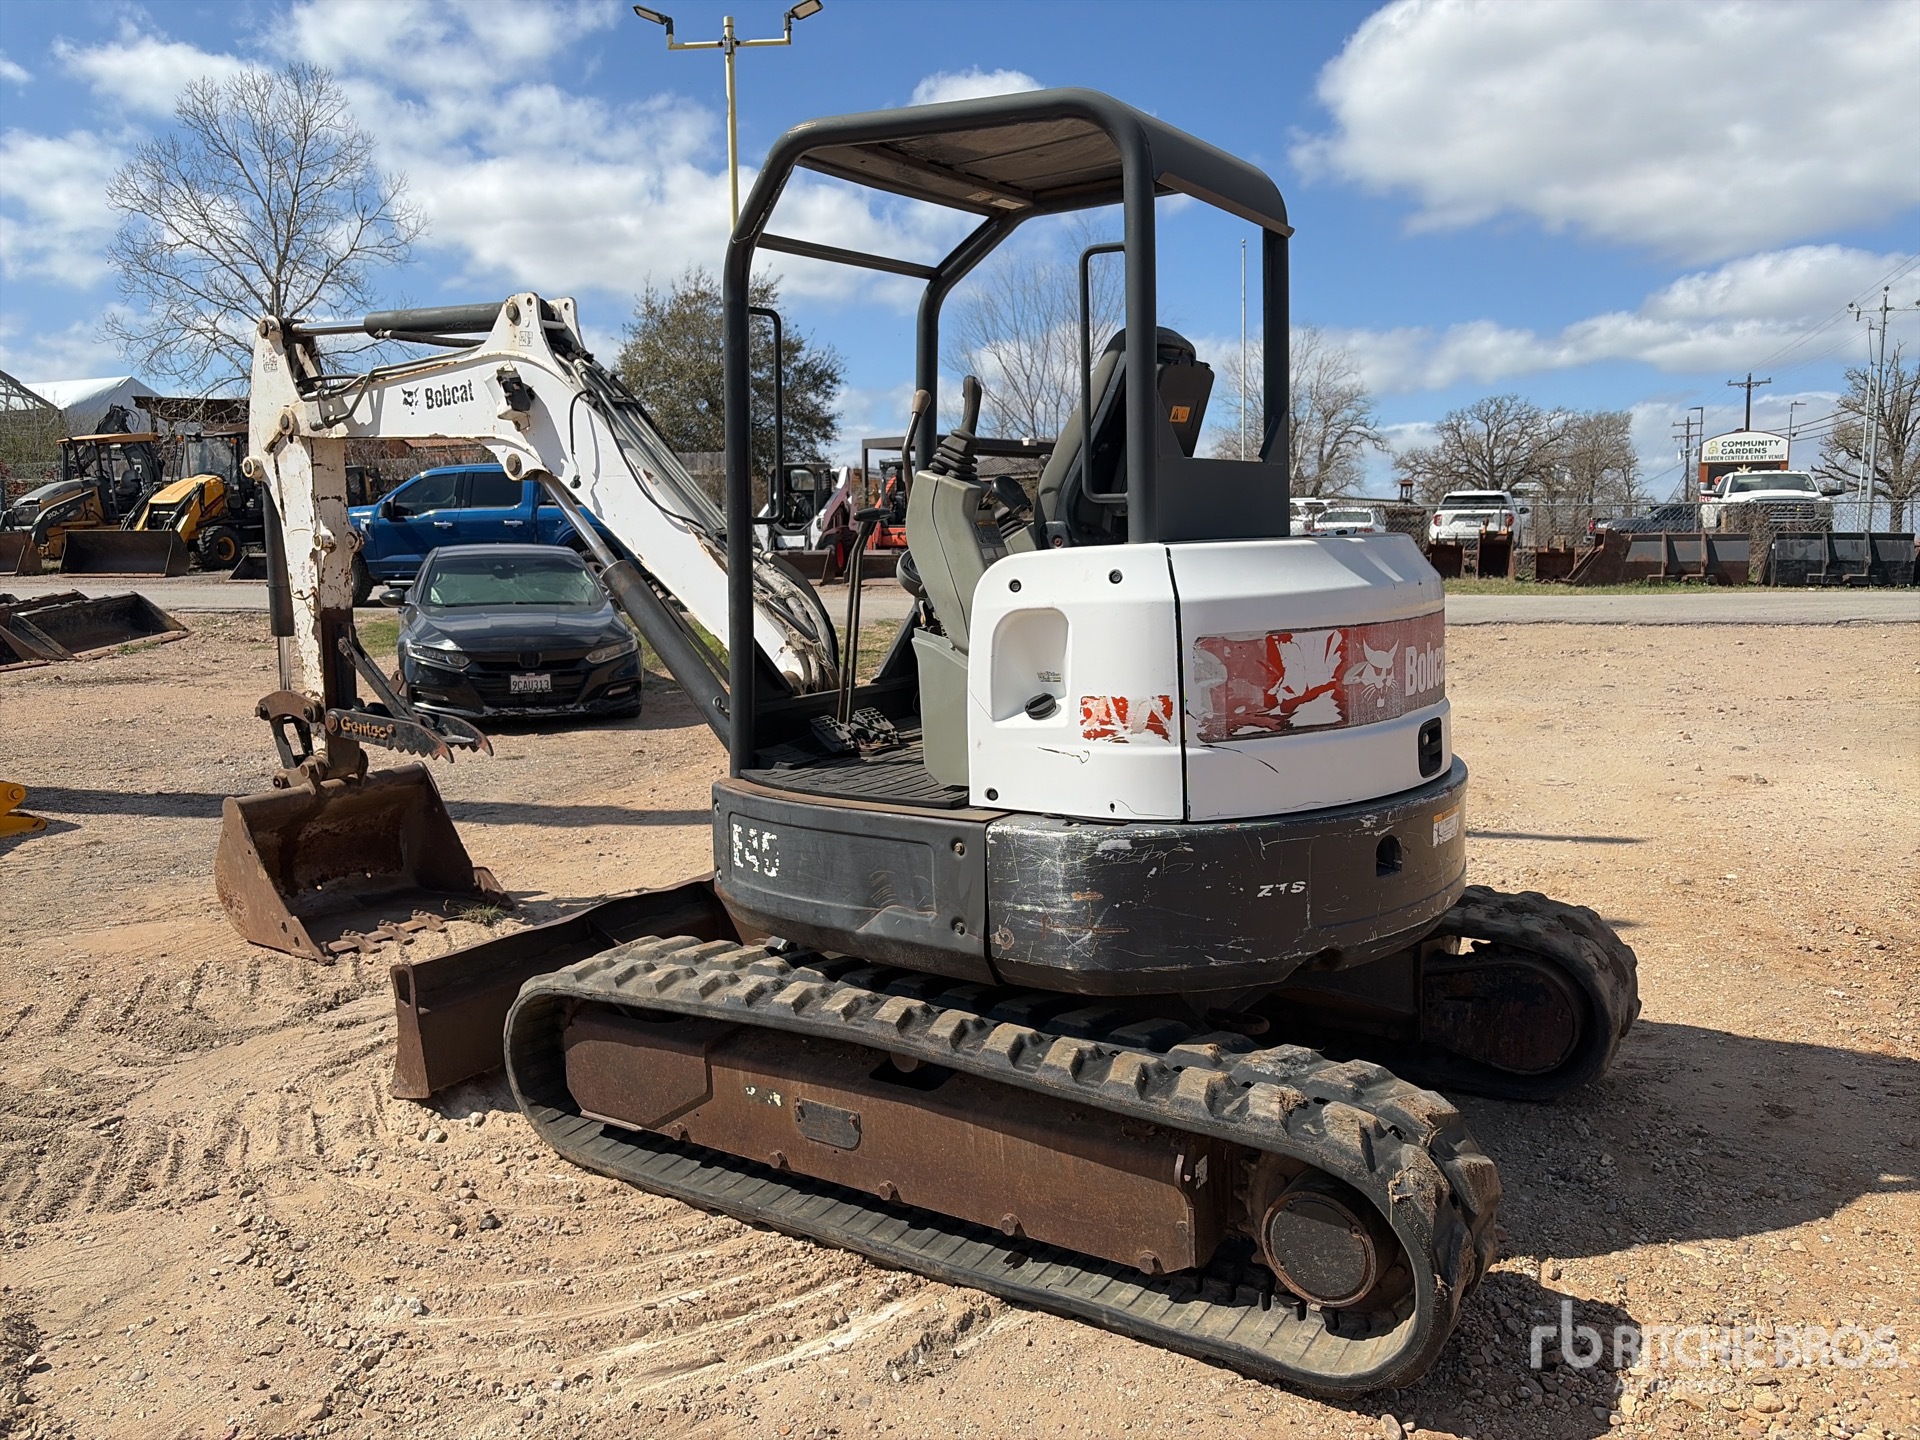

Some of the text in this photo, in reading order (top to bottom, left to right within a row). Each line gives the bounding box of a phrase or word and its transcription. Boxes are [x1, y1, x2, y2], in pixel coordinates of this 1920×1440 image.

[425, 379, 474, 410] Bobcat
[1721, 440, 1781, 448] COMMUNITY
[1721, 447, 1767, 455] GARDENS
[512, 680, 550, 690] 9CAU313
